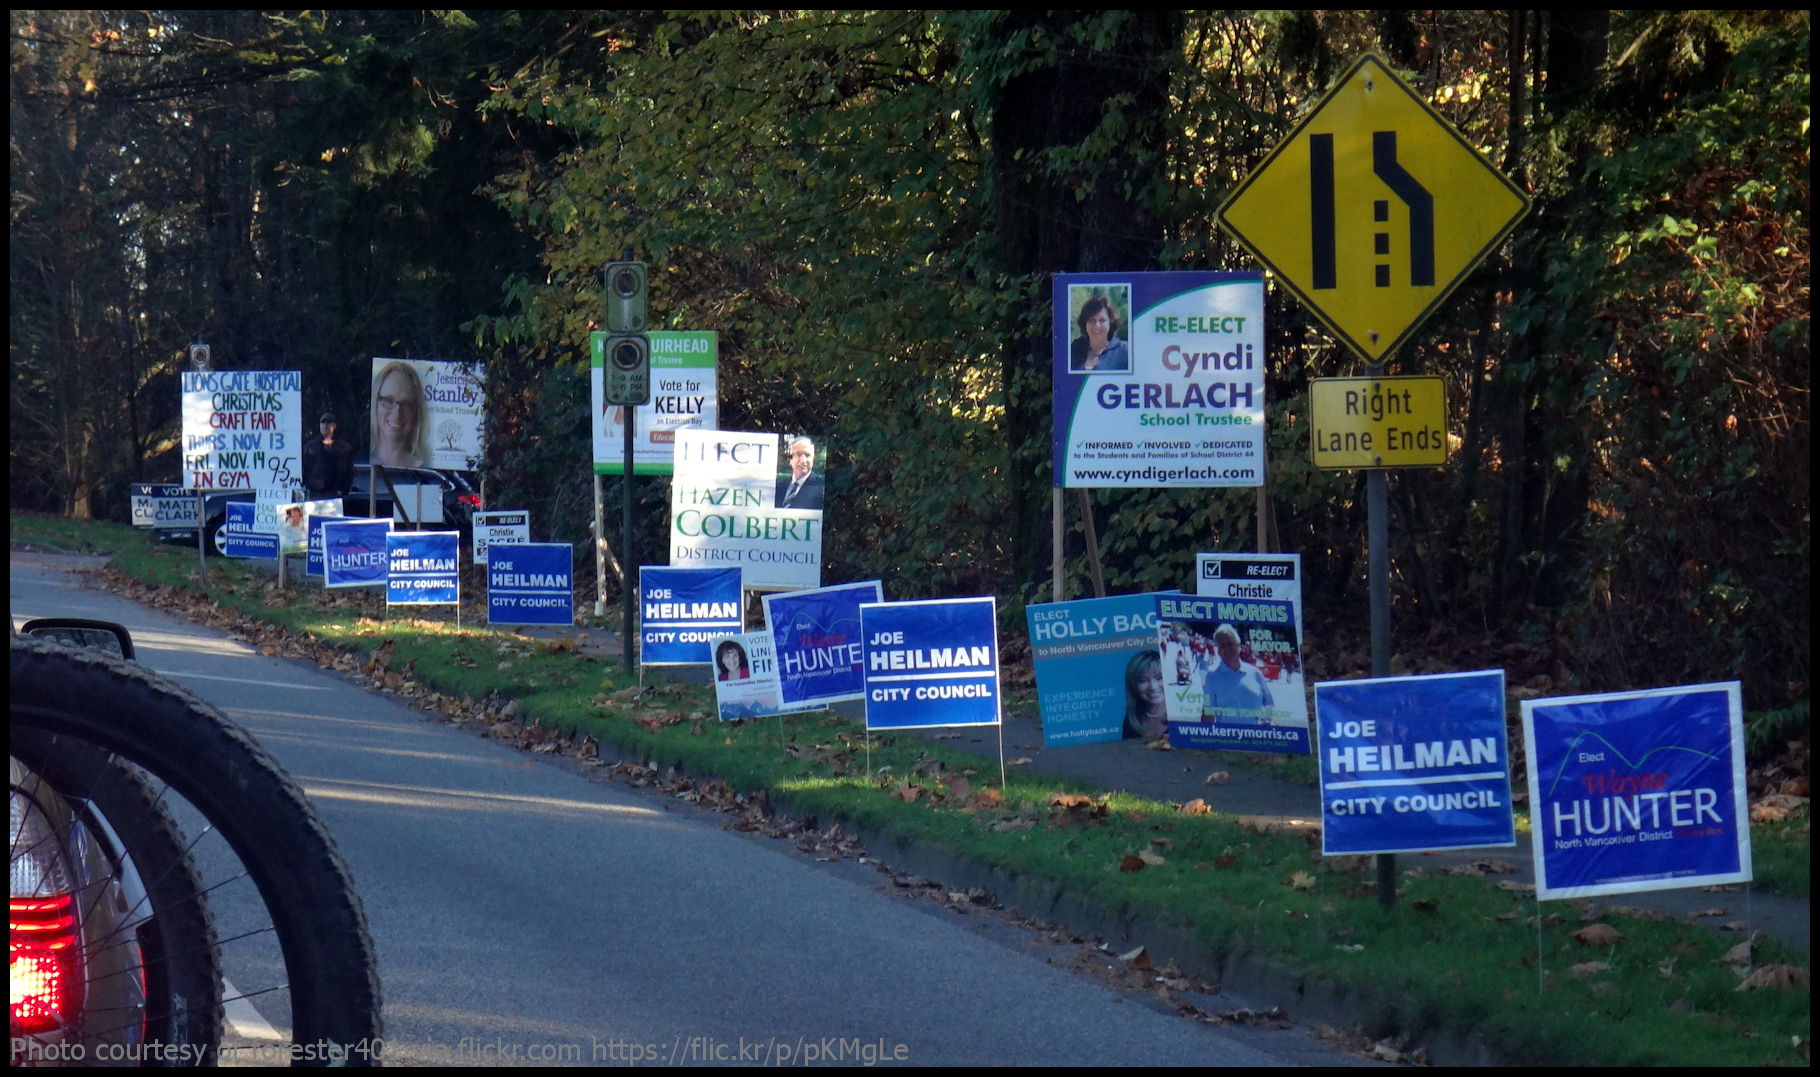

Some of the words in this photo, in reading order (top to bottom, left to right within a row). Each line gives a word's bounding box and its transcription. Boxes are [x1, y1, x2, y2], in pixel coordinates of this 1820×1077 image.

[1155, 316, 1246, 333] RE-ELECT
[1162, 343, 1253, 378] Cyndi
[184, 372, 219, 393] LIONS
[220, 372, 250, 392] GATE
[254, 371, 302, 392] HOSPITAL
[660, 379, 682, 391] Vote
[686, 379, 701, 391] for
[424, 385, 478, 407] Stanley
[1097, 382, 1253, 410] GERLACH
[655, 396, 705, 414] KELLY
[1345, 388, 1412, 422] Right
[210, 412, 247, 430] CRAFT
[251, 412, 276, 430] FAIR
[665, 417, 689, 425] Election
[691, 417, 703, 426] Day
[1140, 413, 1190, 426] School
[1195, 413, 1252, 426] Trustee
[269, 433, 285, 450] 13
[1085, 441, 1133, 450] INFORMED
[1144, 441, 1191, 449] INVOLVED
[1203, 440, 1253, 449] DEDICATED
[1317, 429, 1372, 452] Lane
[1387, 425, 1442, 450] Ends
[218, 452, 250, 469] NOV.
[253, 451, 265, 469] 14
[193, 471, 213, 488] IN
[218, 471, 251, 488] GYM
[1074, 466, 1254, 483] www.cyndigerlach.com
[162, 487, 192, 496] VOTE
[679, 484, 763, 507] HAZEN
[158, 500, 197, 510] MATT
[256, 503, 277, 513] HAZ
[229, 514, 242, 522] JOE
[676, 509, 819, 542] COLBERT
[490, 528, 515, 537] Christie
[228, 538, 244, 546] CITY
[245, 539, 275, 548] COUNCIL
[331, 552, 388, 568] HUNTER
[391, 548, 409, 558] JOE
[676, 545, 745, 561] DISTRICT
[748, 548, 818, 565] COUNCIL
[390, 558, 455, 572] HEILMAN
[492, 560, 513, 571] JOE
[1246, 565, 1289, 577] RE-ELECT
[390, 579, 412, 589] CITY
[414, 579, 455, 589] COUNCIL
[491, 574, 568, 588] HEILMAN
[646, 589, 672, 600] JOE
[1227, 583, 1273, 599] Christie
[492, 597, 516, 607] CITY
[519, 597, 568, 608] COUNCIL
[645, 602, 738, 619] HEILMAN
[1033, 609, 1071, 622] ELECT
[1160, 599, 1214, 619] ELECT
[1217, 602, 1289, 623] MORRIS
[796, 622, 811, 631] Elect
[1035, 616, 1108, 641] HOLLY
[1248, 628, 1274, 641] FOR
[646, 632, 676, 643] CITY
[748, 636, 769, 645] VOTE
[870, 631, 904, 646] JOE
[1039, 648, 1049, 656] to
[1050, 645, 1076, 655] North
[1077, 640, 1125, 652] Vancouver
[1127, 637, 1145, 648] City
[1250, 640, 1292, 654] MAYOR
[870, 646, 990, 671] HEILMAN
[833, 666, 852, 674] District
[871, 687, 911, 702] CITY
[915, 684, 992, 699] COUNCIL
[1044, 688, 1117, 704] EXPERIENCE
[1045, 699, 1106, 714] INTEGRITY
[1047, 710, 1102, 724] HONESTY
[1050, 725, 1120, 740] www.hollyback.ca
[1178, 724, 1299, 741] www.kerrymorris.ca
[1329, 720, 1376, 739] JOE
[1329, 737, 1498, 774] HEILMAN
[1578, 752, 1606, 764] Elect
[1582, 768, 1669, 800] Wayne
[1331, 797, 1387, 816] CITY
[1393, 790, 1501, 813] COUNCIL
[1553, 788, 1723, 838] HUNTER
[1555, 838, 1582, 850] North
[1584, 833, 1636, 848] Vancouver
[1639, 830, 1674, 842] District
